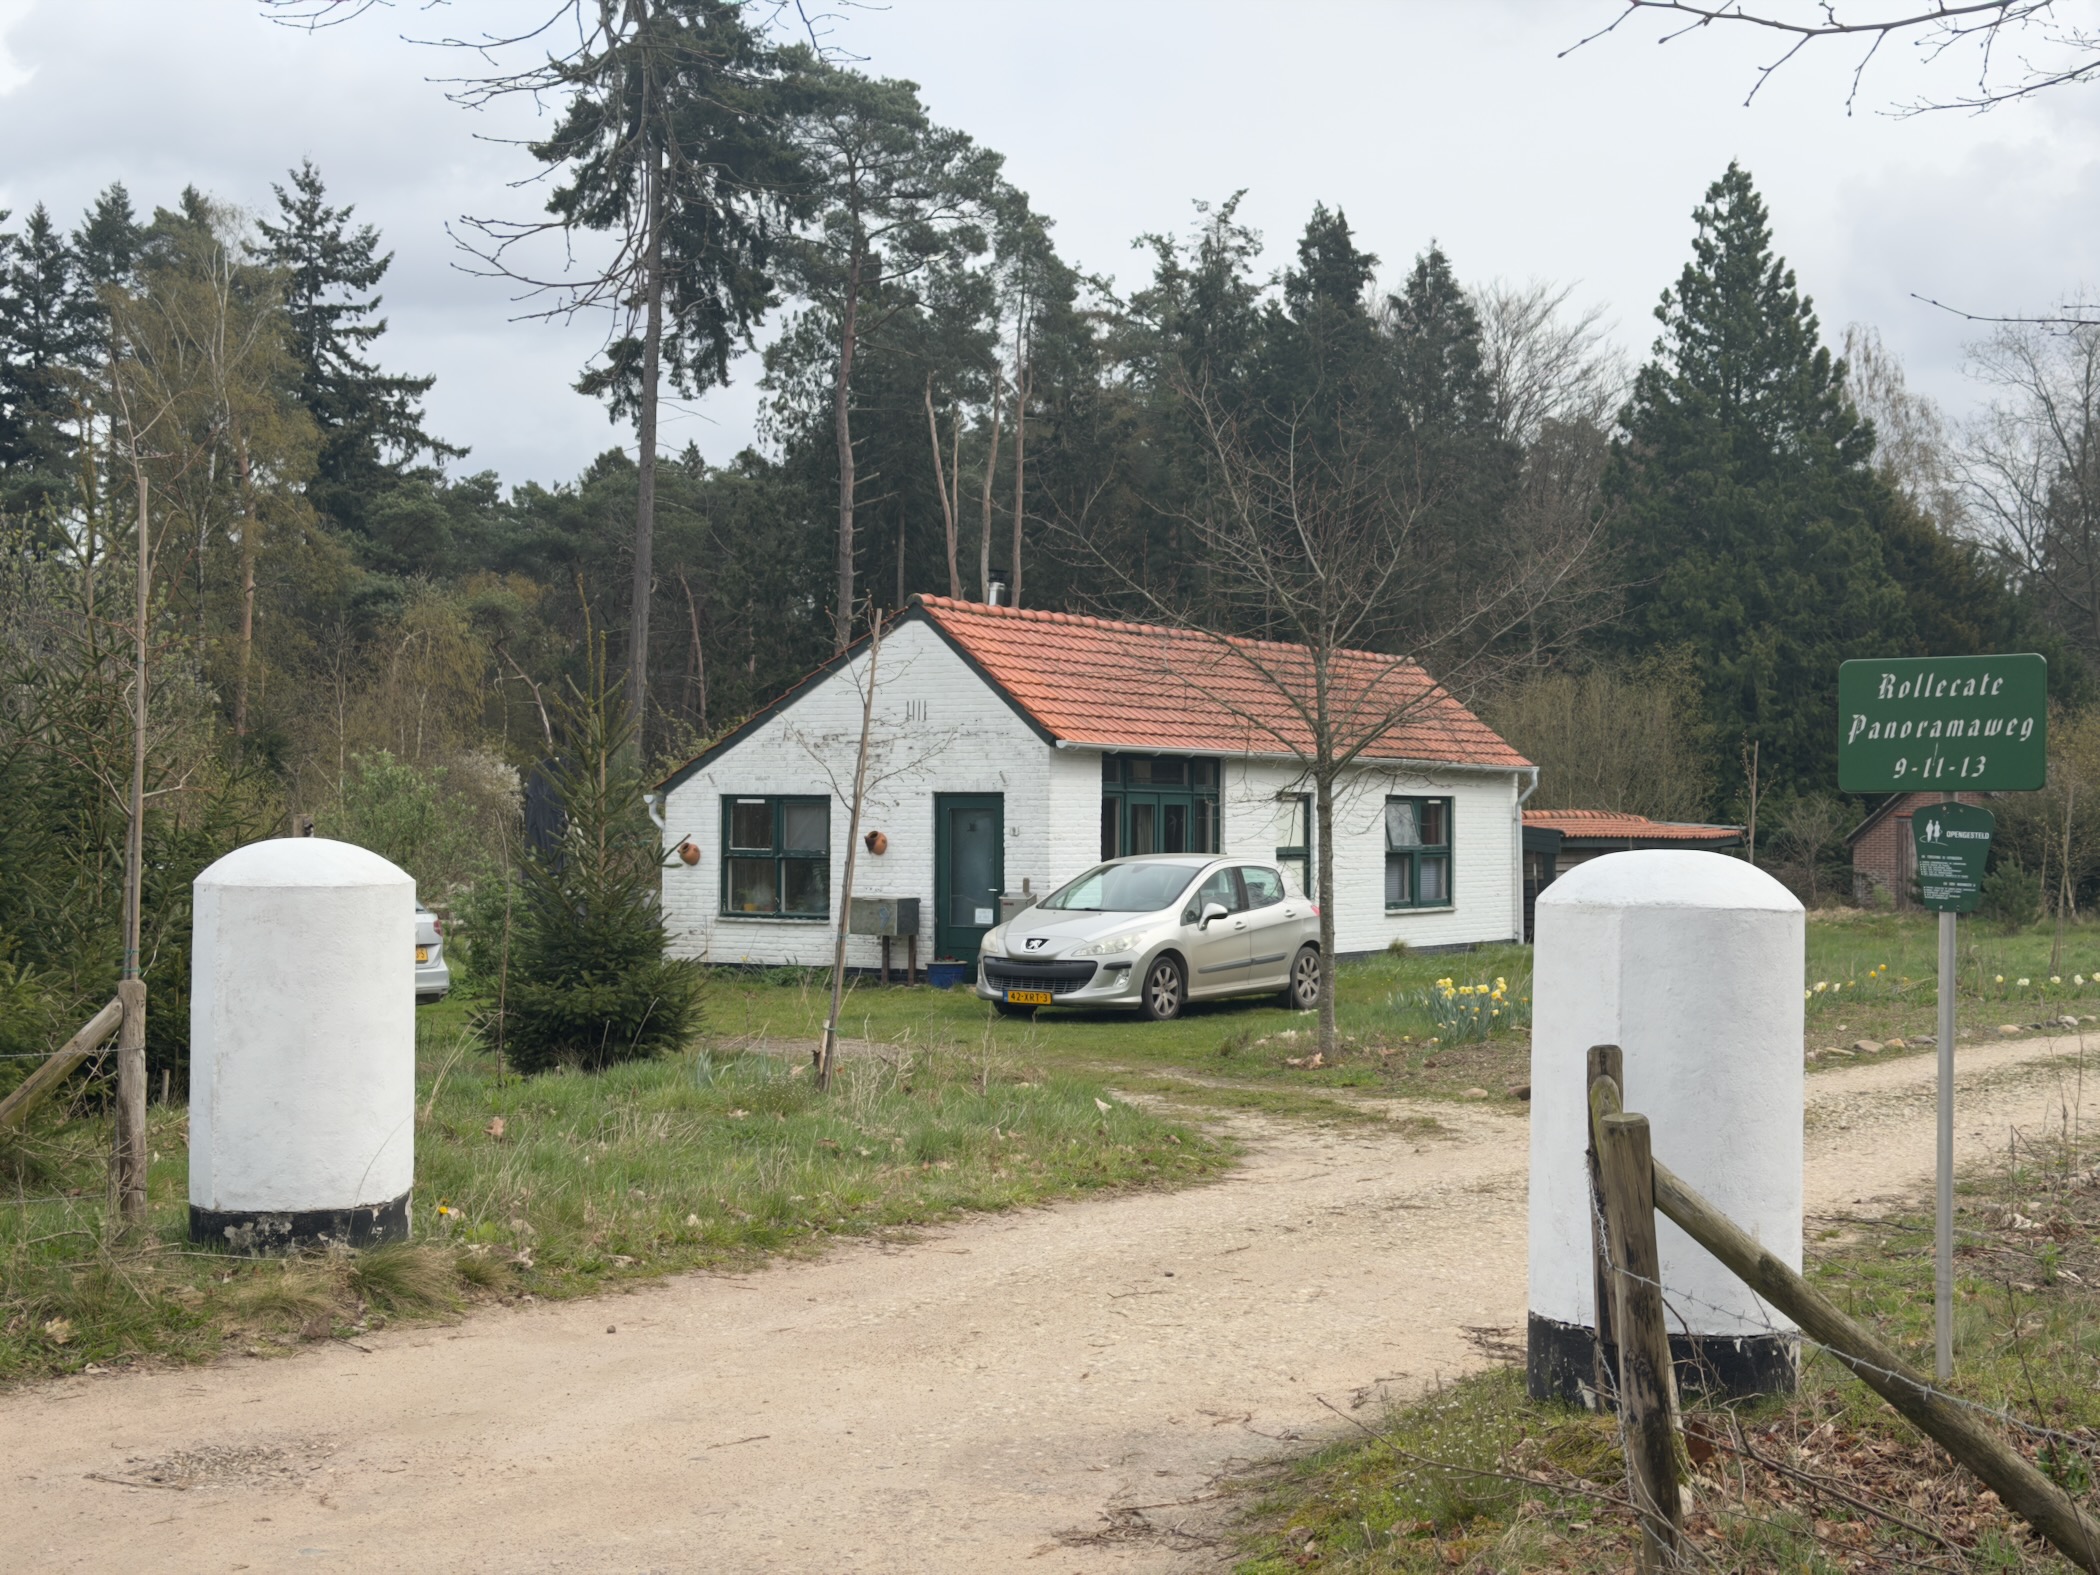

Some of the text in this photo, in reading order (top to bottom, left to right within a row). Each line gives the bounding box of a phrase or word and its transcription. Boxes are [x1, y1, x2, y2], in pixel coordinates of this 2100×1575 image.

[1878, 672, 2003, 699] Rollecate
[1848, 714, 2034, 744] Panoramaweg
[1893, 755, 1986, 778] 9-11-13
[1946, 831, 1990, 839] OPENGESTELD
